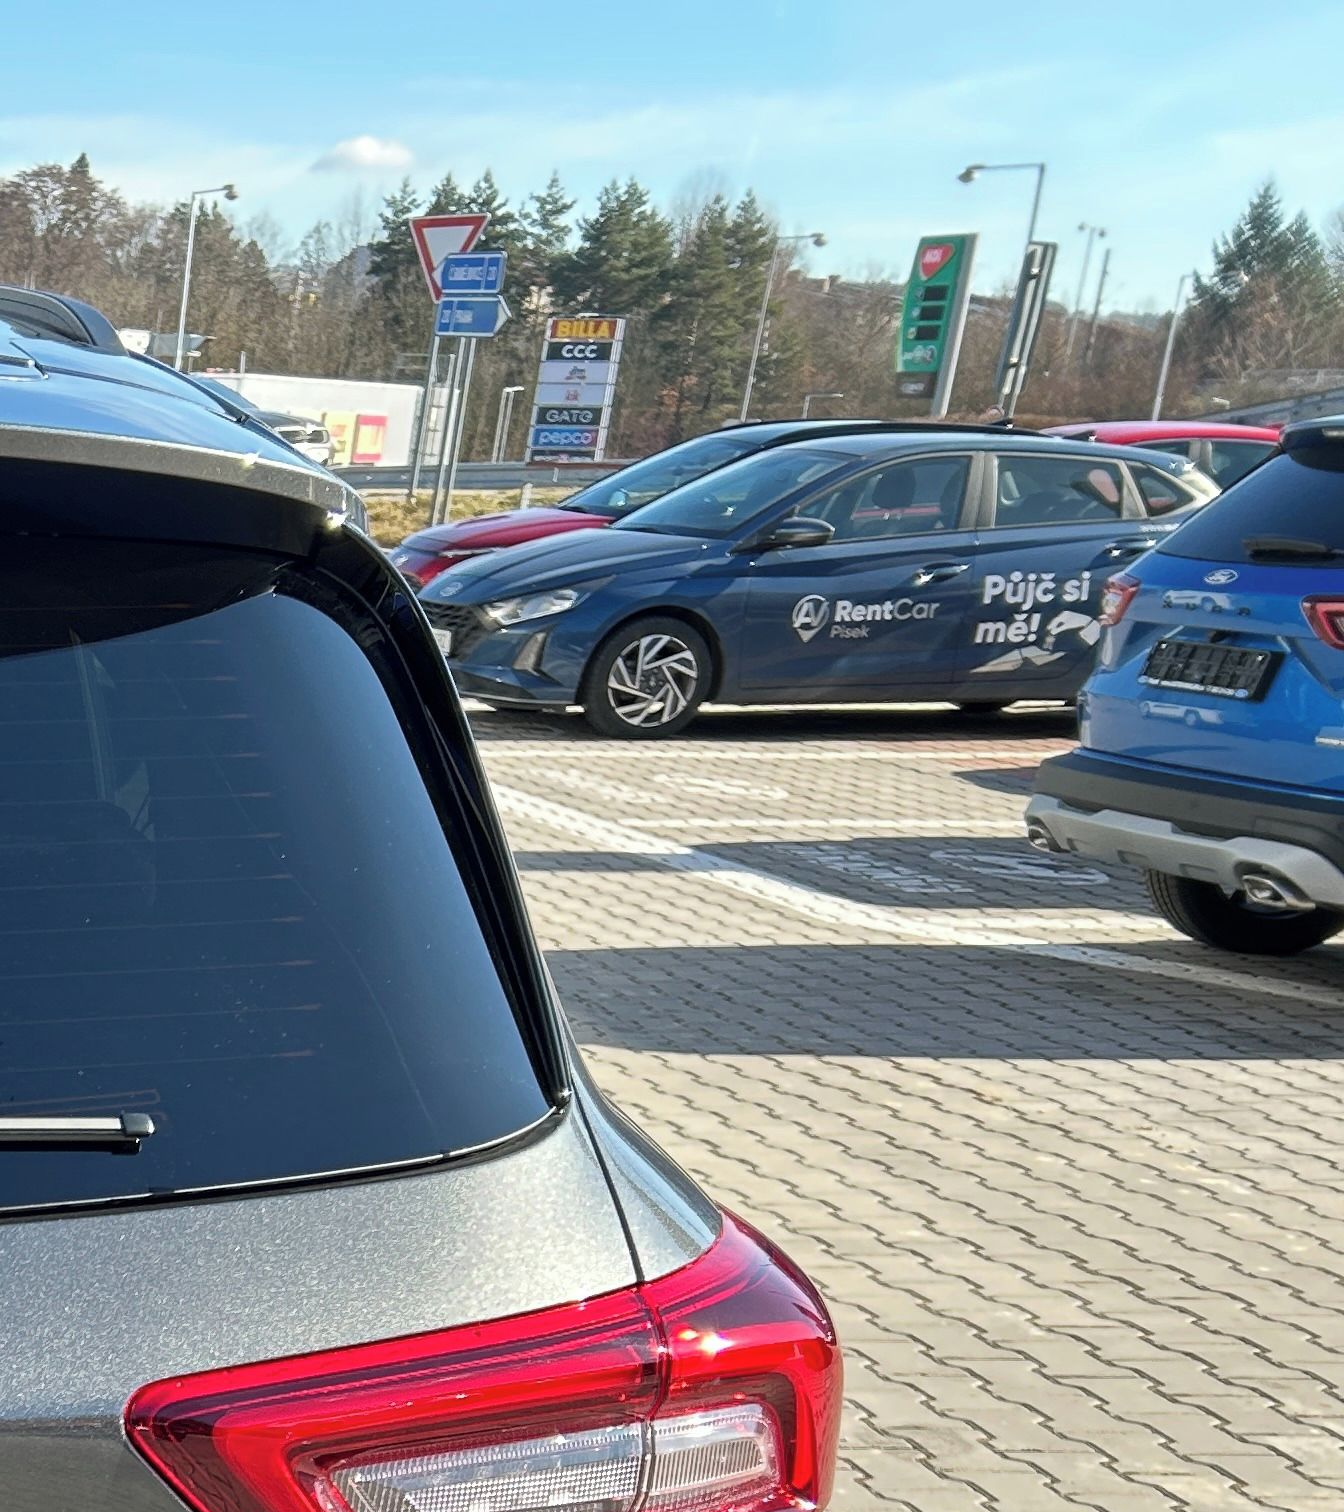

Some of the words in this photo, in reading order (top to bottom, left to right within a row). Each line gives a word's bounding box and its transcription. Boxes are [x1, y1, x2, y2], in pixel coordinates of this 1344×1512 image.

[555, 319, 611, 338] BILLA
[561, 344, 598, 358] CCC
[538, 431, 593, 445] pepco
[983, 571, 1057, 611] Půjč
[1062, 571, 1093, 602] si
[833, 598, 941, 624] RentCar
[974, 613, 1040, 644] mě!
